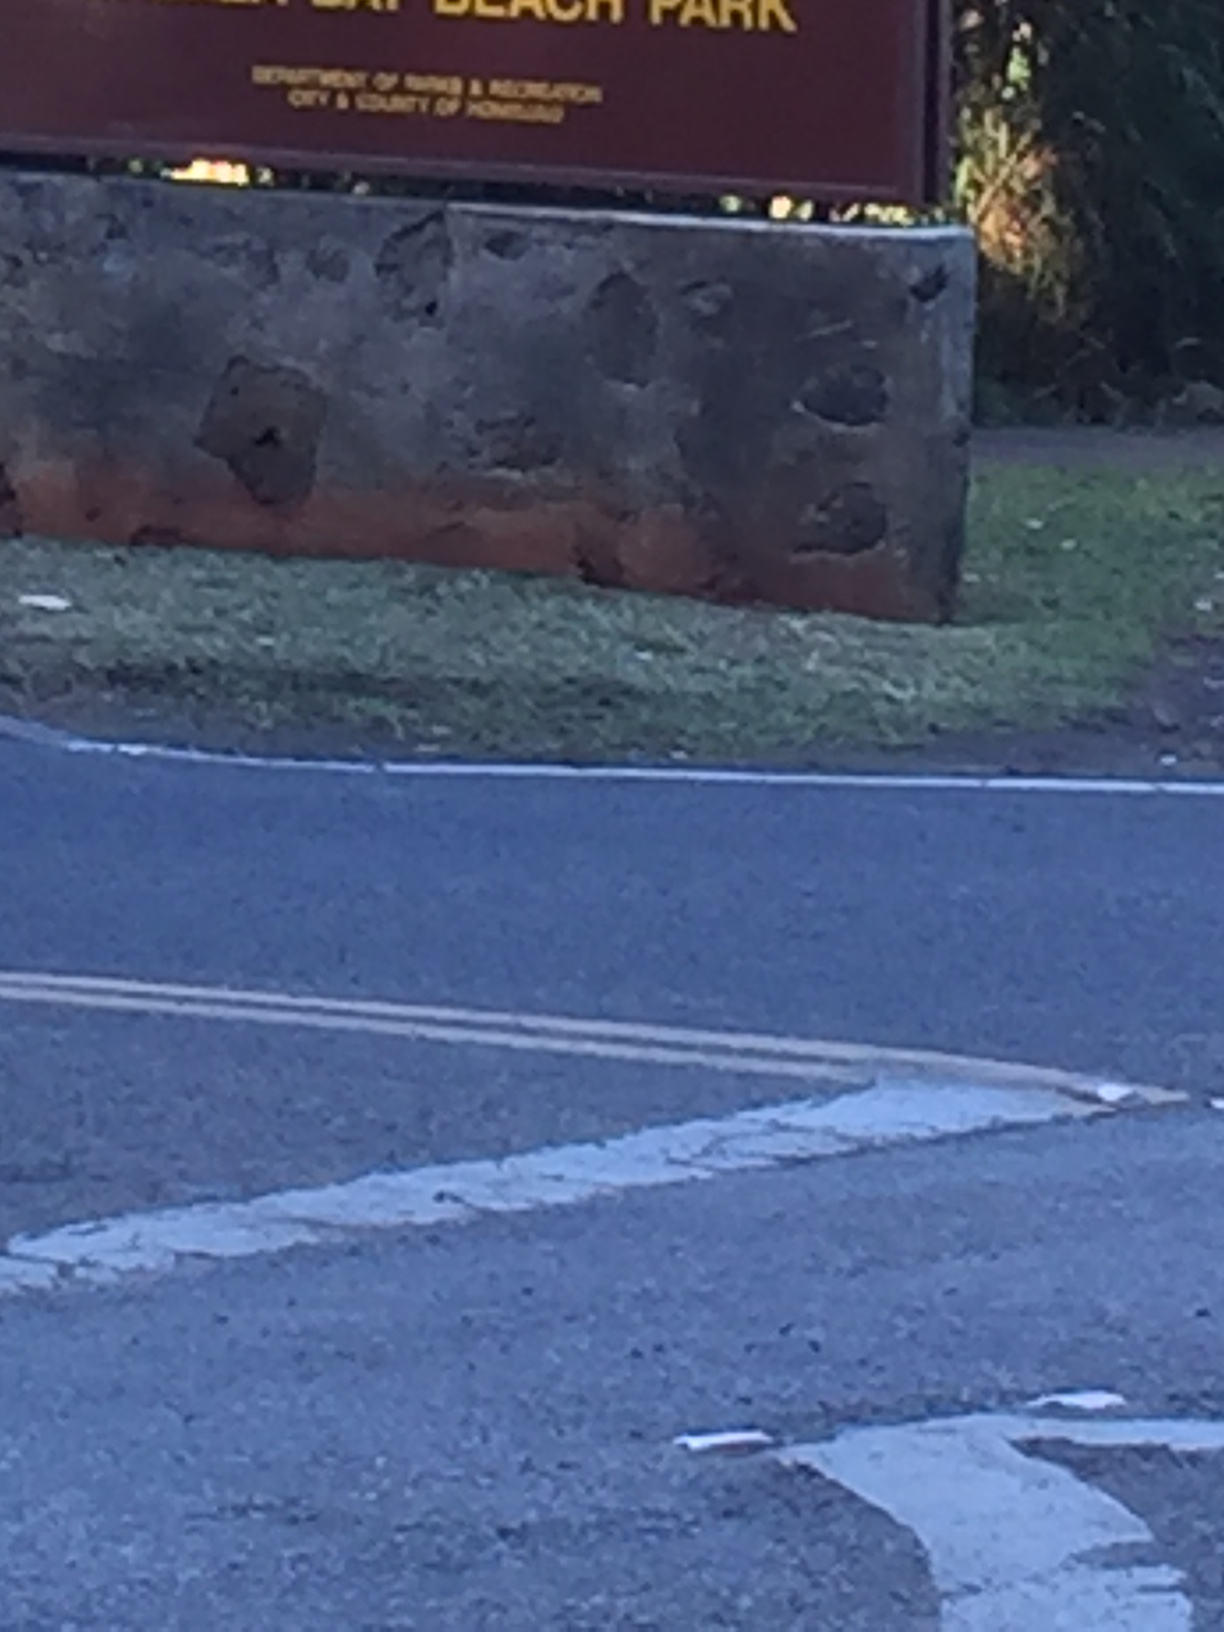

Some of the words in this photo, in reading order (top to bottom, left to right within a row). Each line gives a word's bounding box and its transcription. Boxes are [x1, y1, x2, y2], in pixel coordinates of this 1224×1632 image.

[373, 72, 399, 91] OF
[287, 89, 330, 107] CITY
[355, 93, 429, 113] COUNTY
[434, 97, 461, 116] OF
